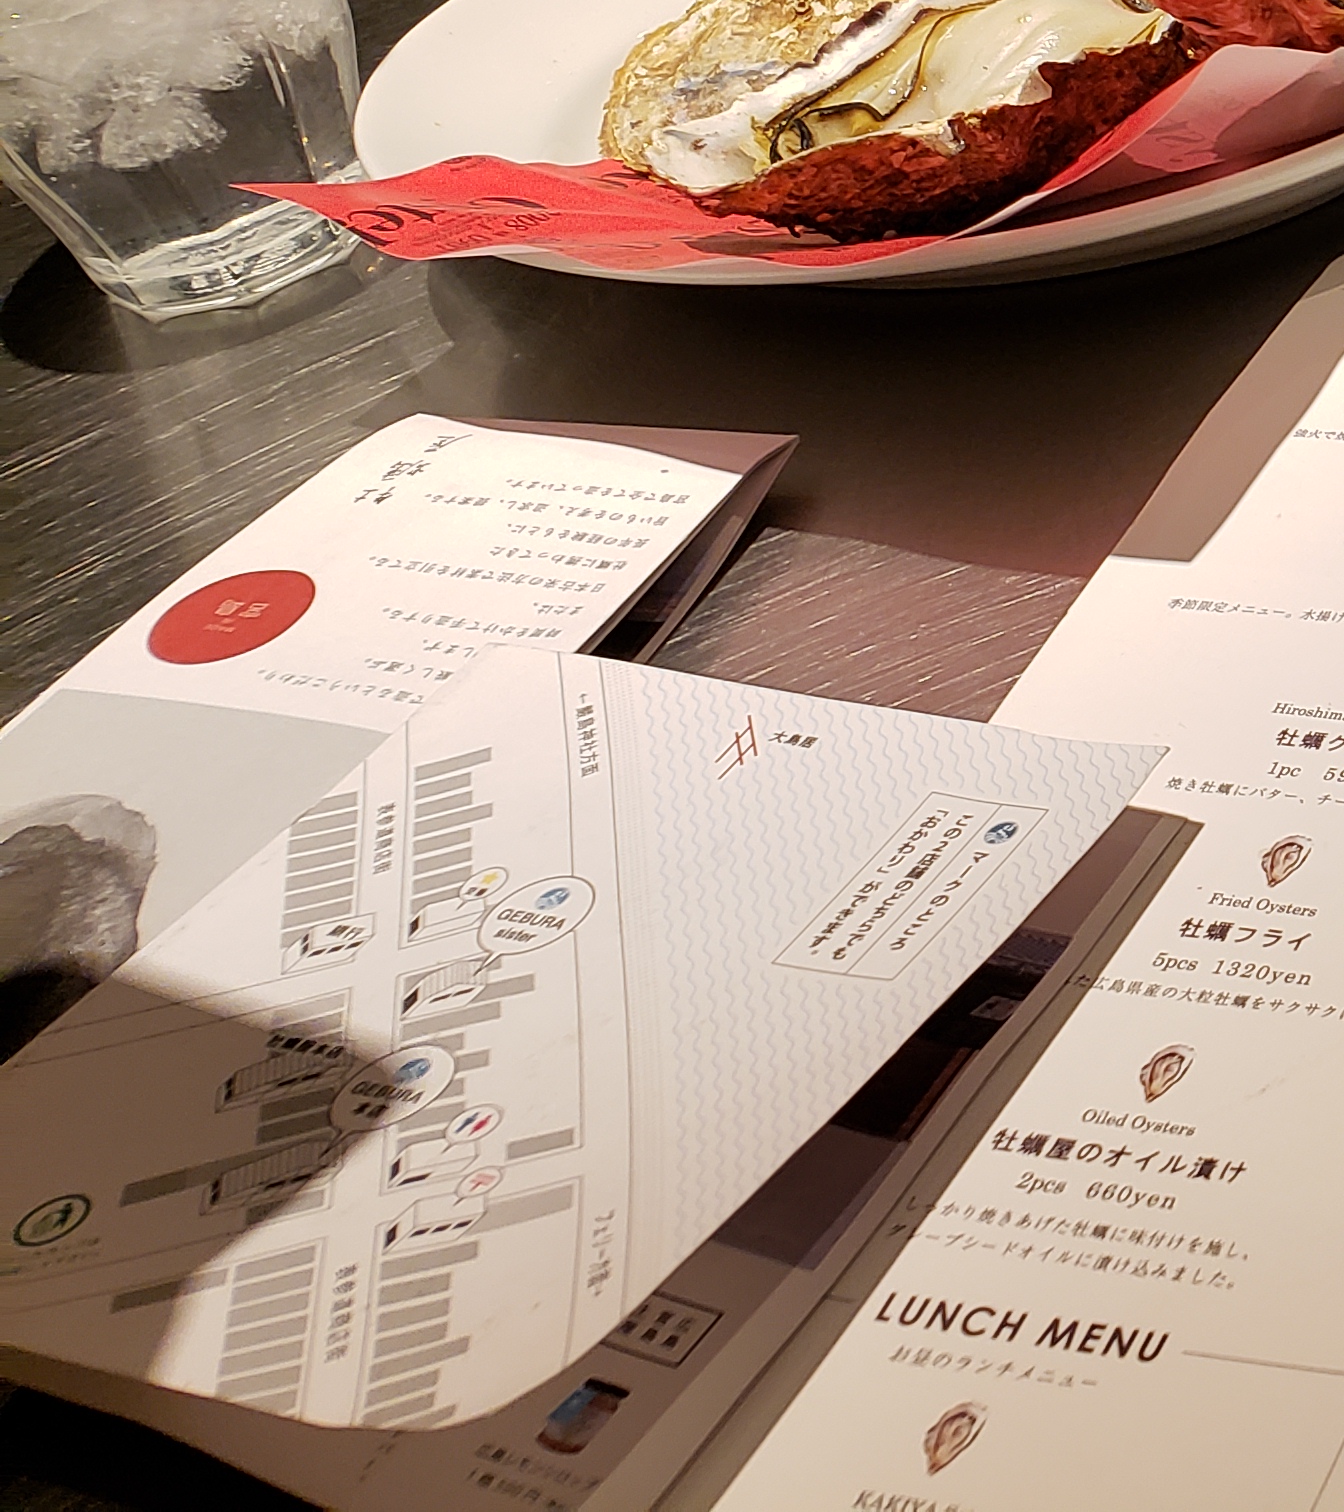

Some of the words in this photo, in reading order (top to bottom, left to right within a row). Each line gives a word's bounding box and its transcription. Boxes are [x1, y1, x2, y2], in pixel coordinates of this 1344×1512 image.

[1266, 761, 1302, 781] 1pc
[1208, 892, 1254, 911] Fried
[1255, 898, 1318, 919] Oysters
[1178, 917, 1314, 953] 牡蠣フライ
[1151, 951, 1199, 976] 5pcs
[1210, 957, 1314, 988] 1320yen
[1080, 1108, 1129, 1130] Oiled
[1131, 1114, 1198, 1139] Oysters
[990, 1127, 1249, 1185] 牡蠣屋のオイル漬け
[1015, 1170, 1068, 1197] 2pcs
[1085, 1179, 1178, 1212] 660yen
[875, 1292, 1028, 1342] LUNCH
[1035, 1317, 1171, 1364] MENU
